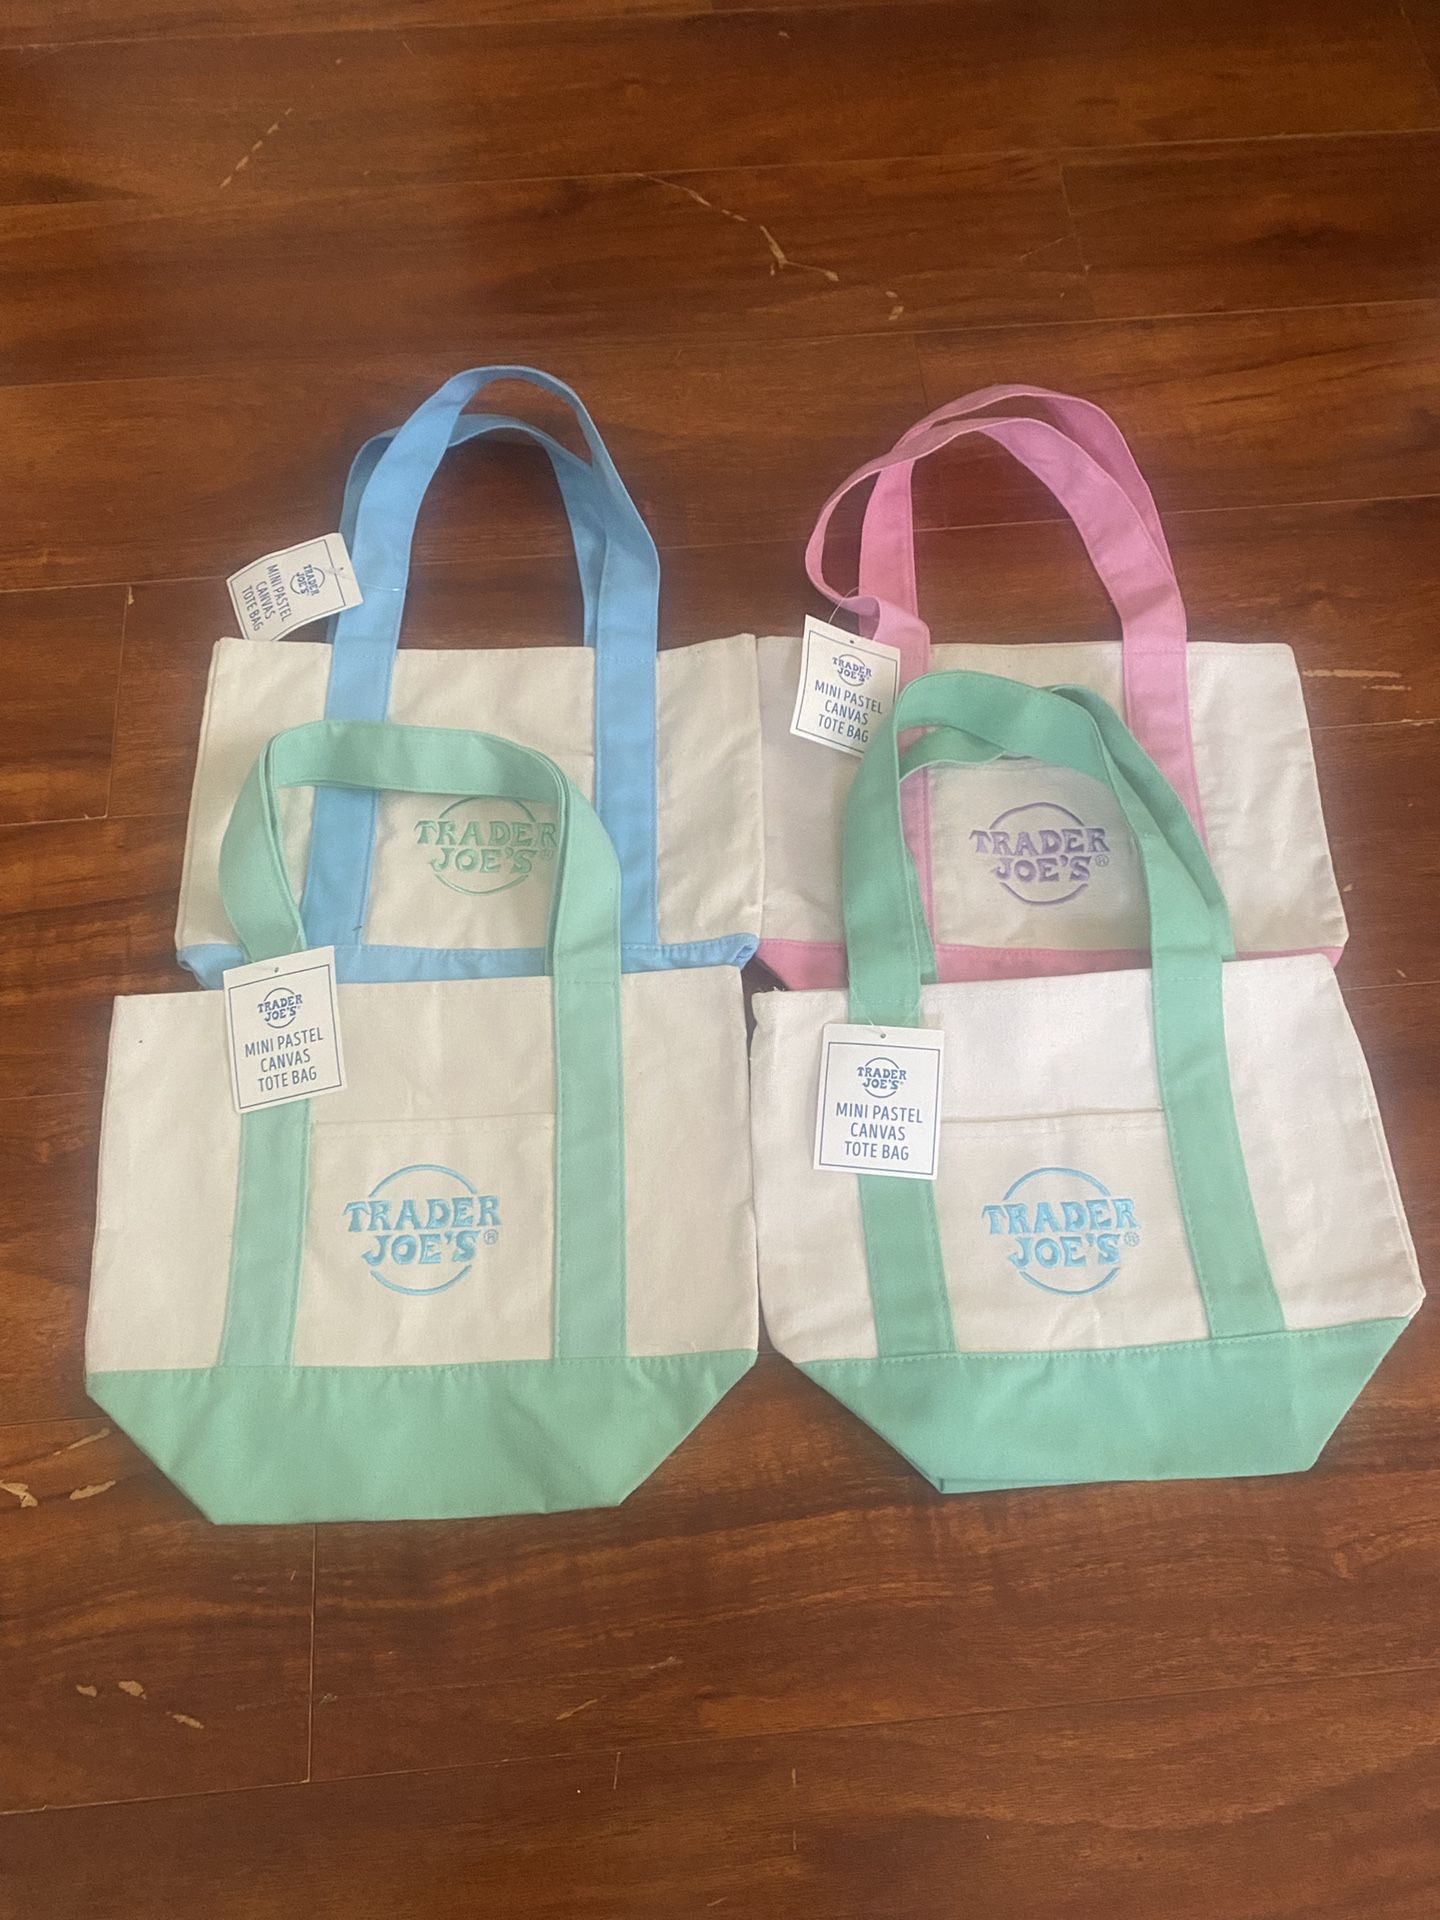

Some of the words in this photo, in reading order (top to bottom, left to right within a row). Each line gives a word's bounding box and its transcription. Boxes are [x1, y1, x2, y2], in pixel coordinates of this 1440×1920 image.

[266, 564, 281, 590] MINI
[274, 586, 292, 622] PASTEL
[303, 564, 320, 596] TRADER
[242, 586, 258, 611] TOTE
[256, 581, 275, 619] CANVAS
[249, 609, 264, 632] BAG
[832, 657, 872, 677] TRADER
[814, 680, 840, 699] MINI
[844, 689, 883, 714] PASTEL
[825, 700, 869, 725] CANVAS
[819, 714, 845, 735] TOTE
[846, 726, 869, 743] BAG
[413, 820, 558, 847] TRADER
[968, 828, 1110, 856] TRADER
[257, 994, 303, 1014] TRADER
[245, 1038, 274, 1057] MINI
[277, 1027, 323, 1050] PASTEL
[260, 1048, 311, 1072] CANVAS
[857, 1066, 907, 1080] TRADER
[258, 1072, 288, 1092] TOTE
[291, 1066, 317, 1085] BAG
[836, 1102, 868, 1119] MINI
[872, 1105, 923, 1123] PASTEL
[850, 1122, 906, 1141] CANVAS
[844, 1141, 878, 1158] TOTE
[881, 1144, 909, 1161] BAG
[342, 1195, 501, 1232] TRADER
[981, 1198, 1141, 1235] TRADER
